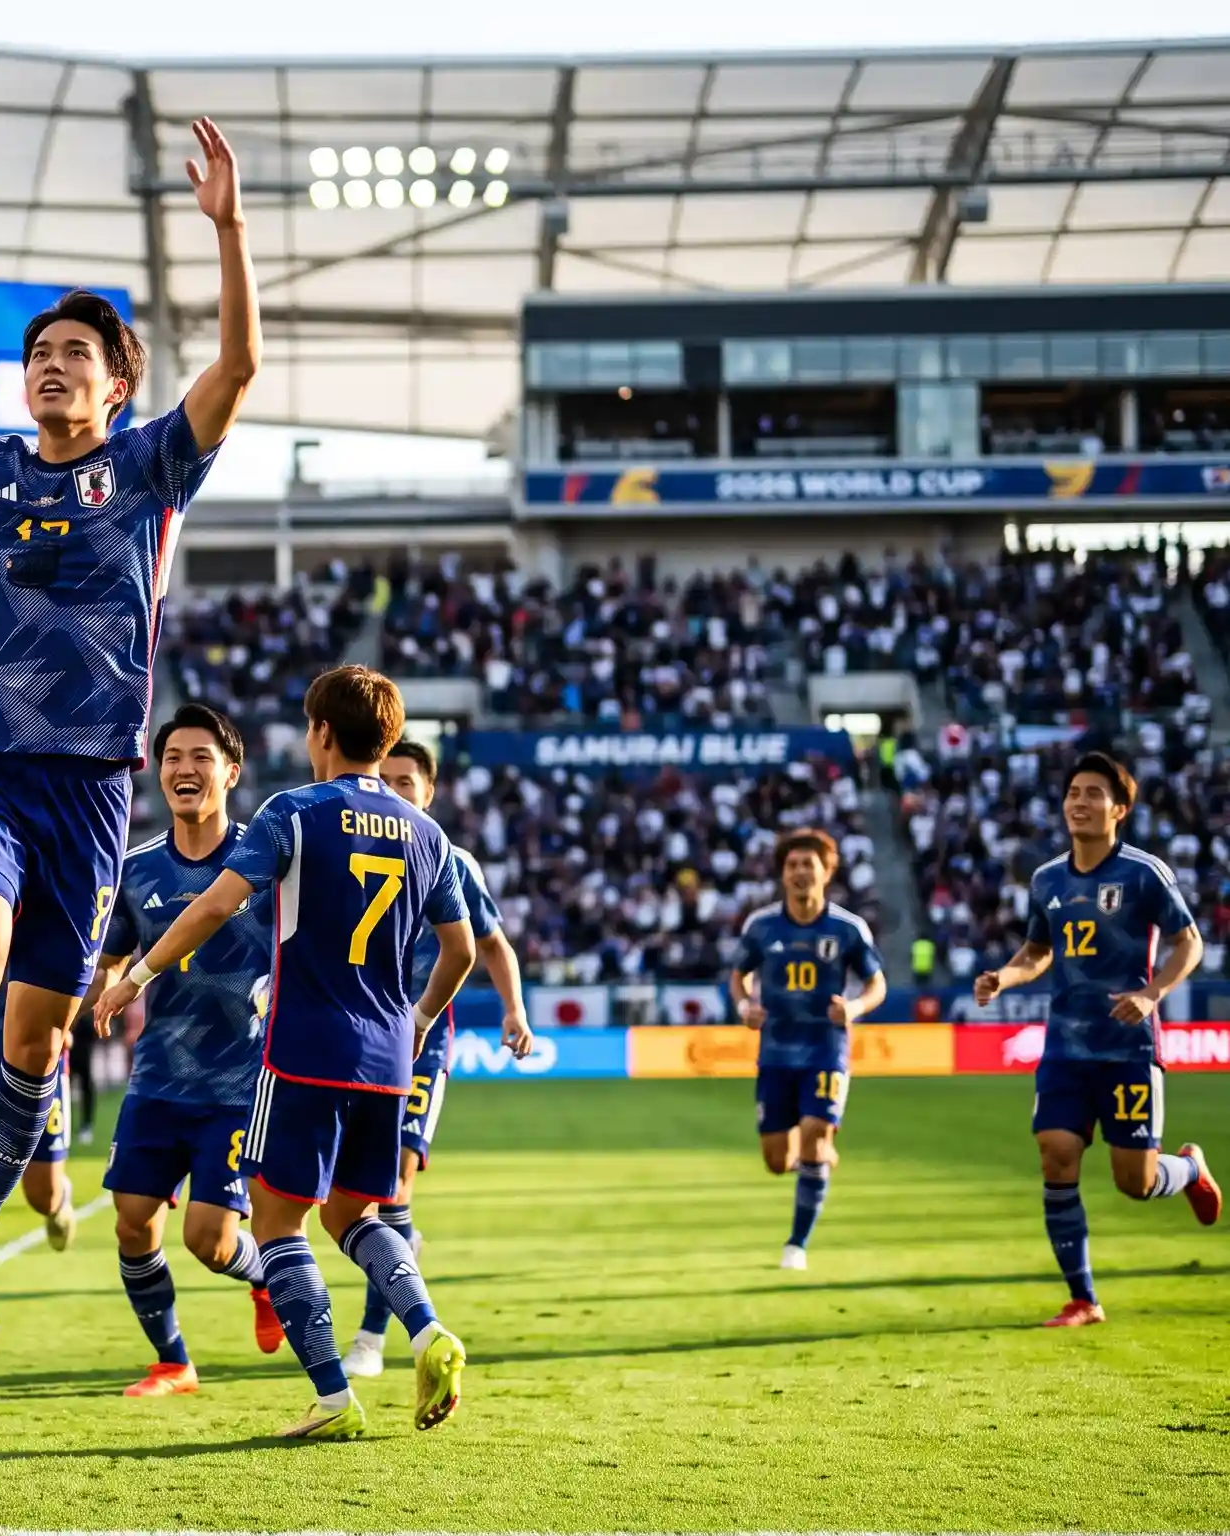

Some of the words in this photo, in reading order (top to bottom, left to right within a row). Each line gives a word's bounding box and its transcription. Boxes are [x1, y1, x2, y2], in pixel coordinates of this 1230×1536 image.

[801, 470, 913, 497] WORLD
[918, 469, 983, 495] CUP
[536, 735, 695, 765] SAMURAI
[699, 734, 788, 764] BLUE
[341, 809, 413, 843] ENDOH
[348, 852, 405, 966] 7
[1063, 920, 1097, 956] 12
[785, 961, 817, 991] 10
[1113, 1084, 1149, 1120] 12
